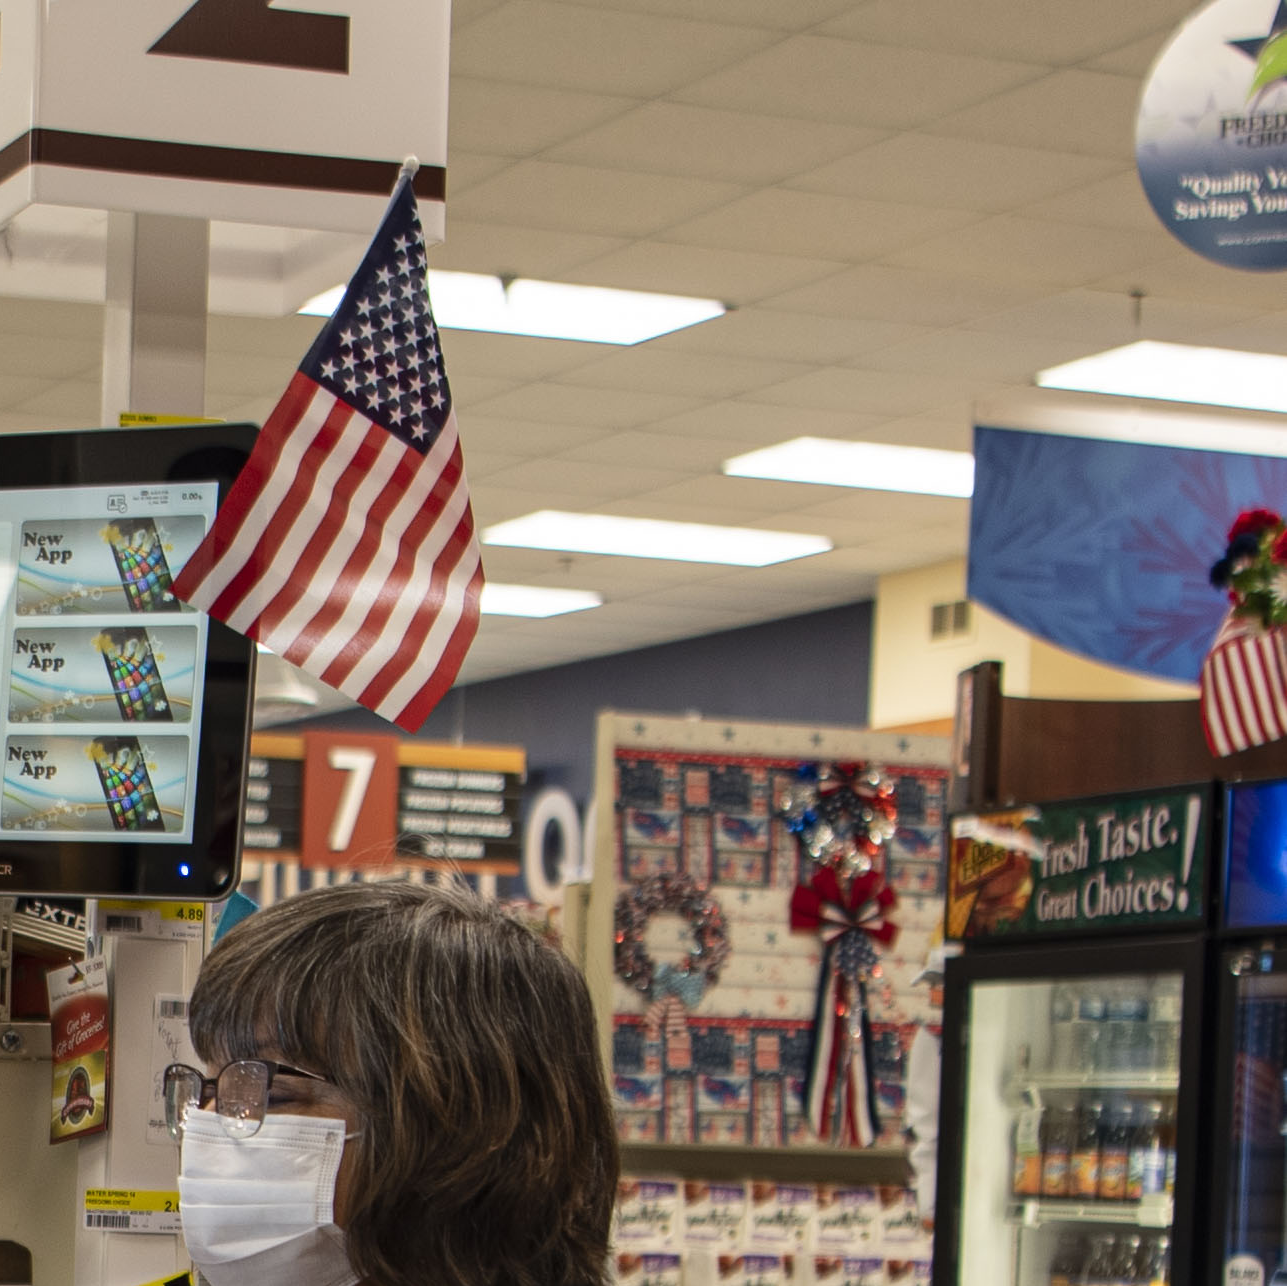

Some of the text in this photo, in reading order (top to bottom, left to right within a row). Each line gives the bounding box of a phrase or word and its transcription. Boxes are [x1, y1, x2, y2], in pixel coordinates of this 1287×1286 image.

[1175, 198, 1248, 222] Savings
[23, 530, 64, 548] New
[35, 545, 73, 565] App
[15, 637, 56, 656] New
[28, 653, 65, 673] App
[7, 745, 49, 762] New
[19, 760, 57, 781] App
[328, 747, 377, 853] 7
[1040, 823, 1089, 879] Fresh
[176, 908, 203, 921] 4.89
[1037, 888, 1078, 922] Great
[80, 1011, 91, 1026] the
[86, 1190, 106, 1198] WATER
